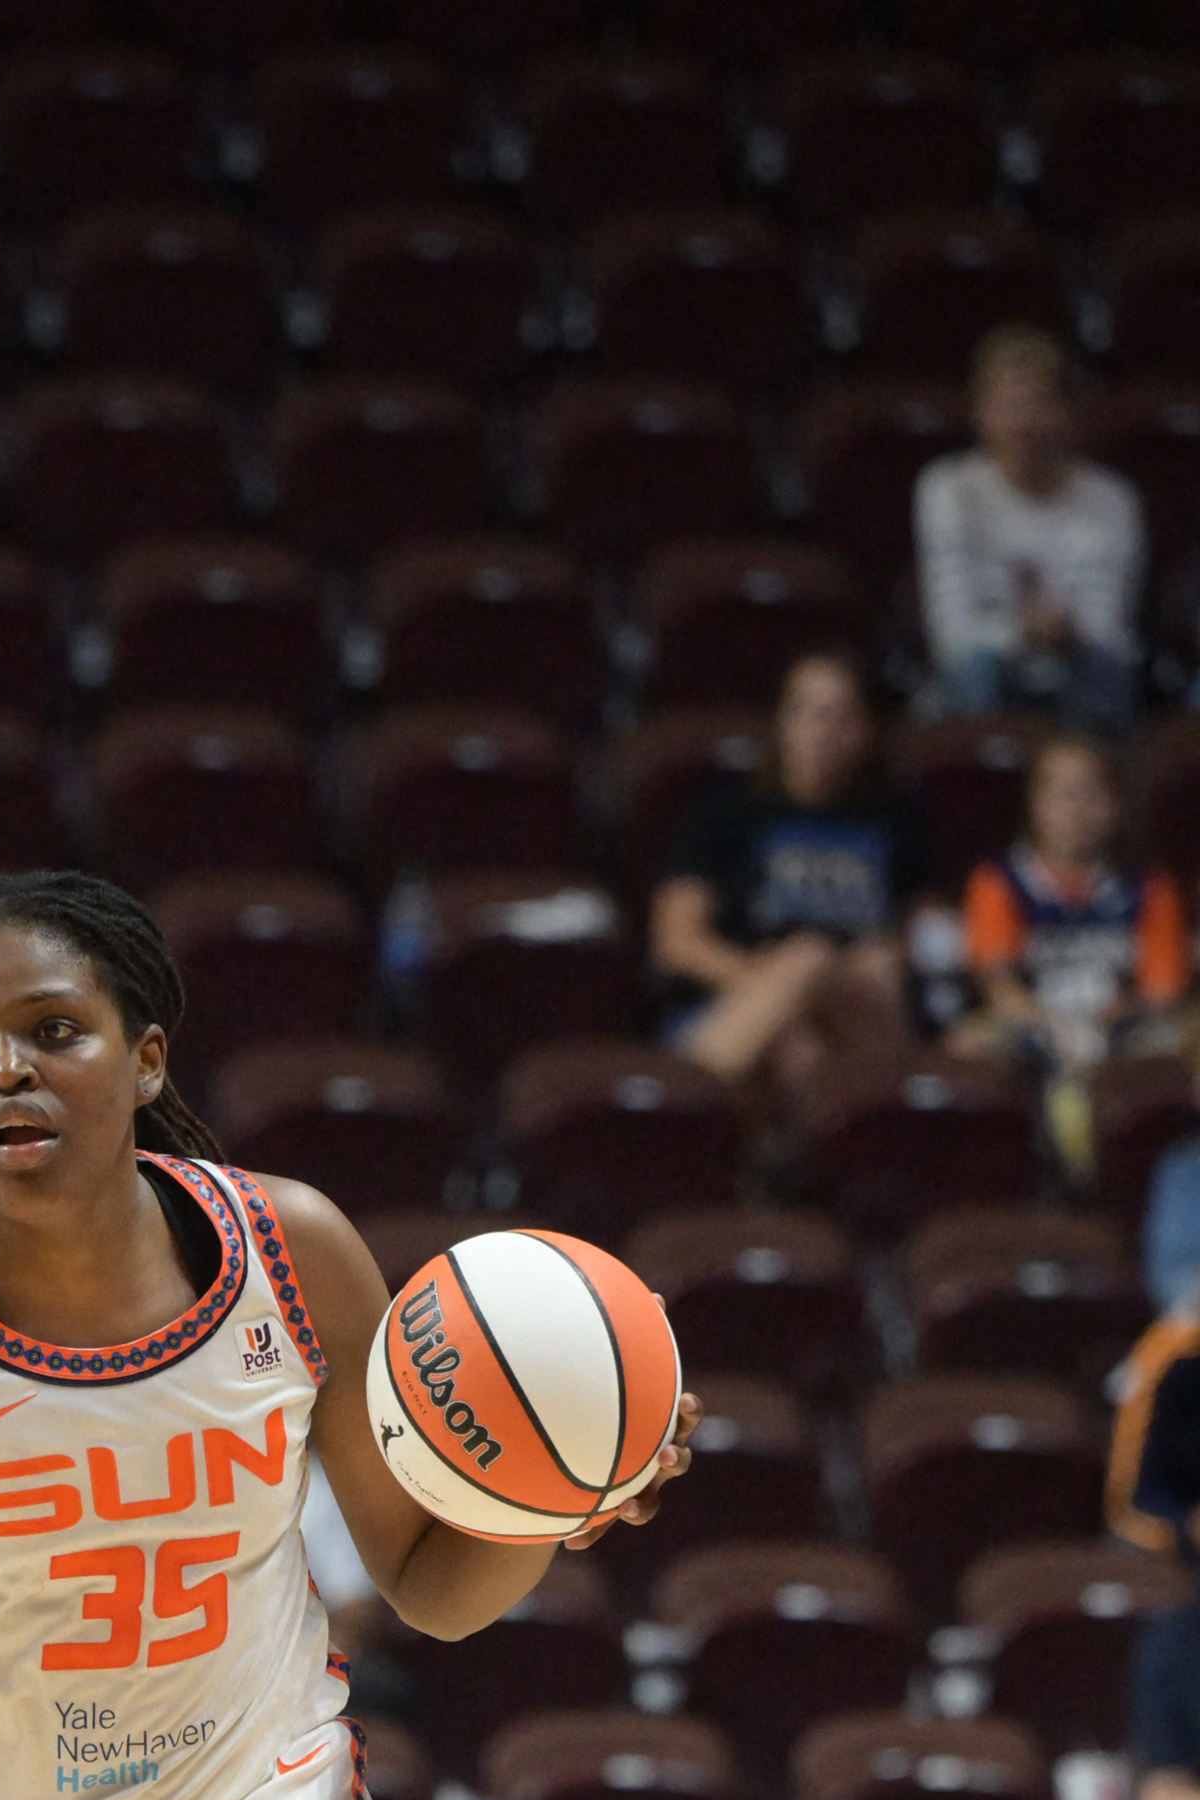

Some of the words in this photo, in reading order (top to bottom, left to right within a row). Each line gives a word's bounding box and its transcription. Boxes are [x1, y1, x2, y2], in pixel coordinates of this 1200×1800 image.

[242, 1346, 282, 1371] Post
[245, 1363, 283, 1377] UNIVERSITY
[399, 1278, 503, 1472] Wilson
[40, 1530, 241, 1671] 35
[54, 1701, 116, 1730] Yale
[57, 1719, 216, 1763] NewHaven
[56, 1758, 159, 1793] Health
